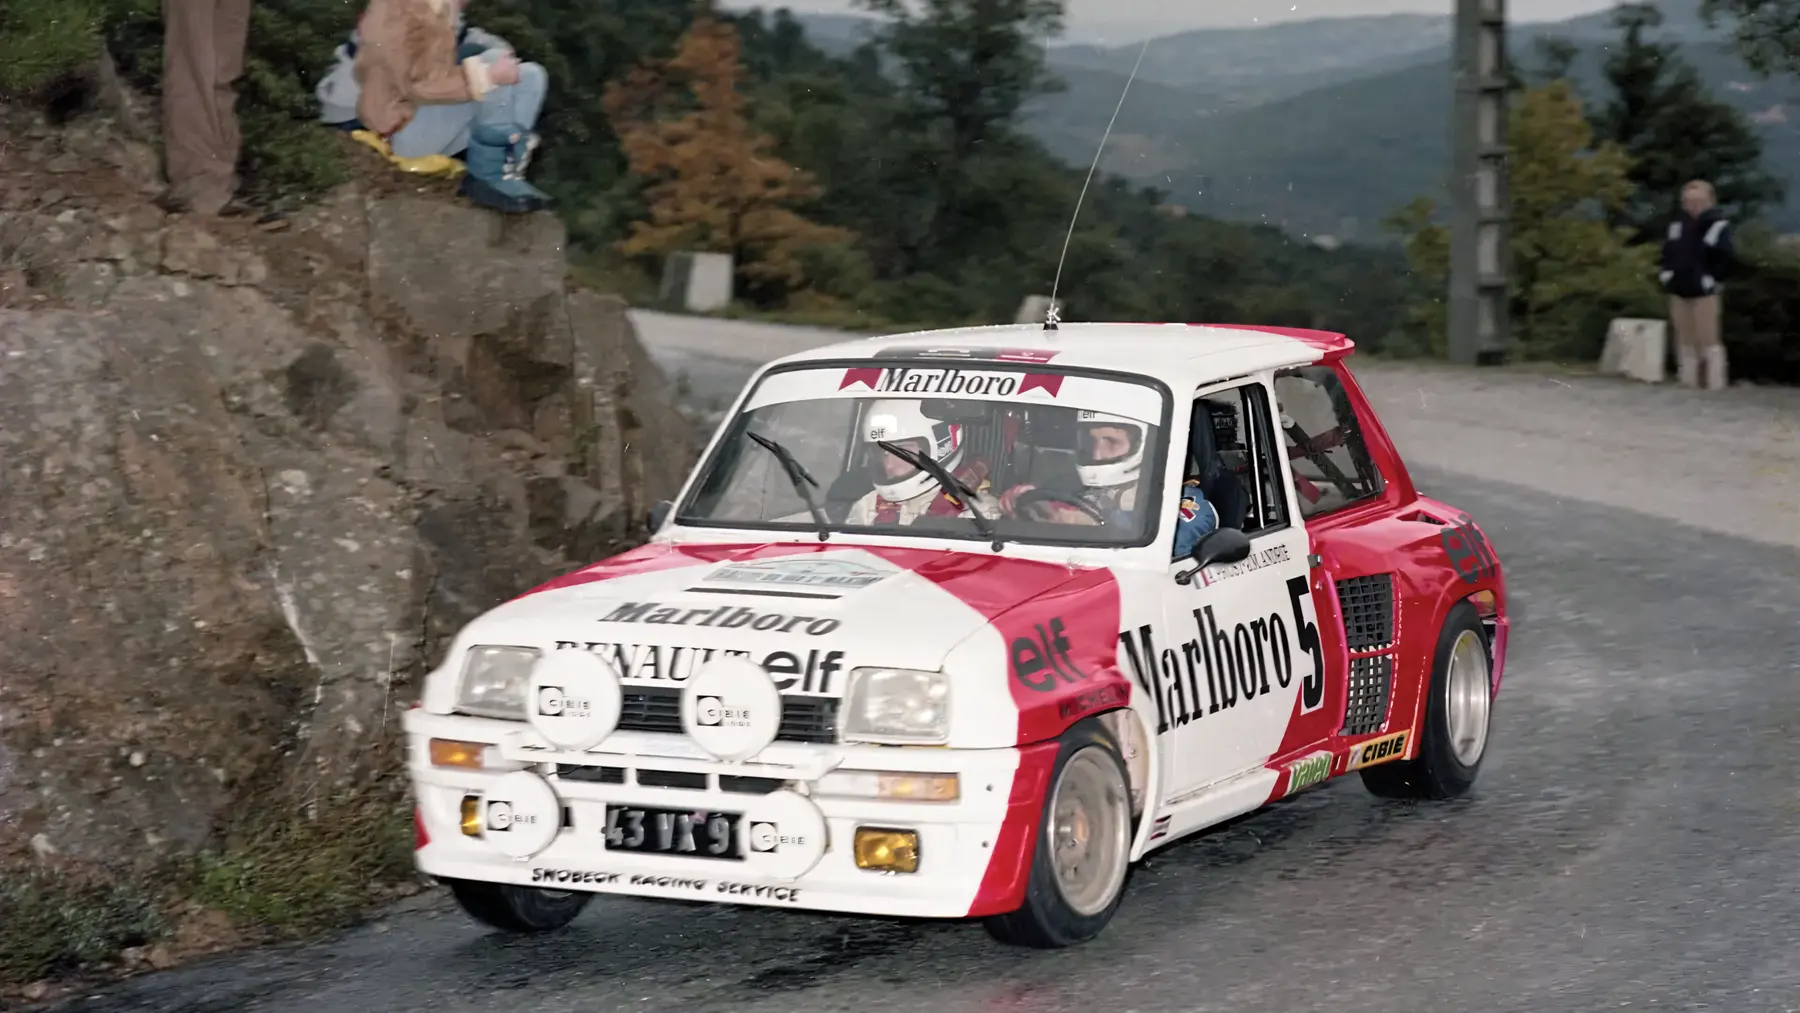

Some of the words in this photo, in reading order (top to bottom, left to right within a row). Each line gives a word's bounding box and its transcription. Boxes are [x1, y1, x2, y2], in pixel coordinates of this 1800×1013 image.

[878, 368, 1016, 396] Marlboro
[870, 428, 885, 439] elf
[1440, 514, 1496, 584] elf
[598, 602, 843, 636] Marlboro
[1286, 575, 1324, 709] 5
[763, 649, 846, 693] elf
[1011, 616, 1087, 693] elf
[1119, 605, 1292, 735] Marlboro
[605, 807, 646, 849] 43
[653, 812, 697, 853] VX
[707, 814, 737, 856] 9
[532, 867, 624, 884] SNOBECK
[630, 873, 708, 890] RACING
[717, 880, 803, 903] SERVICE
